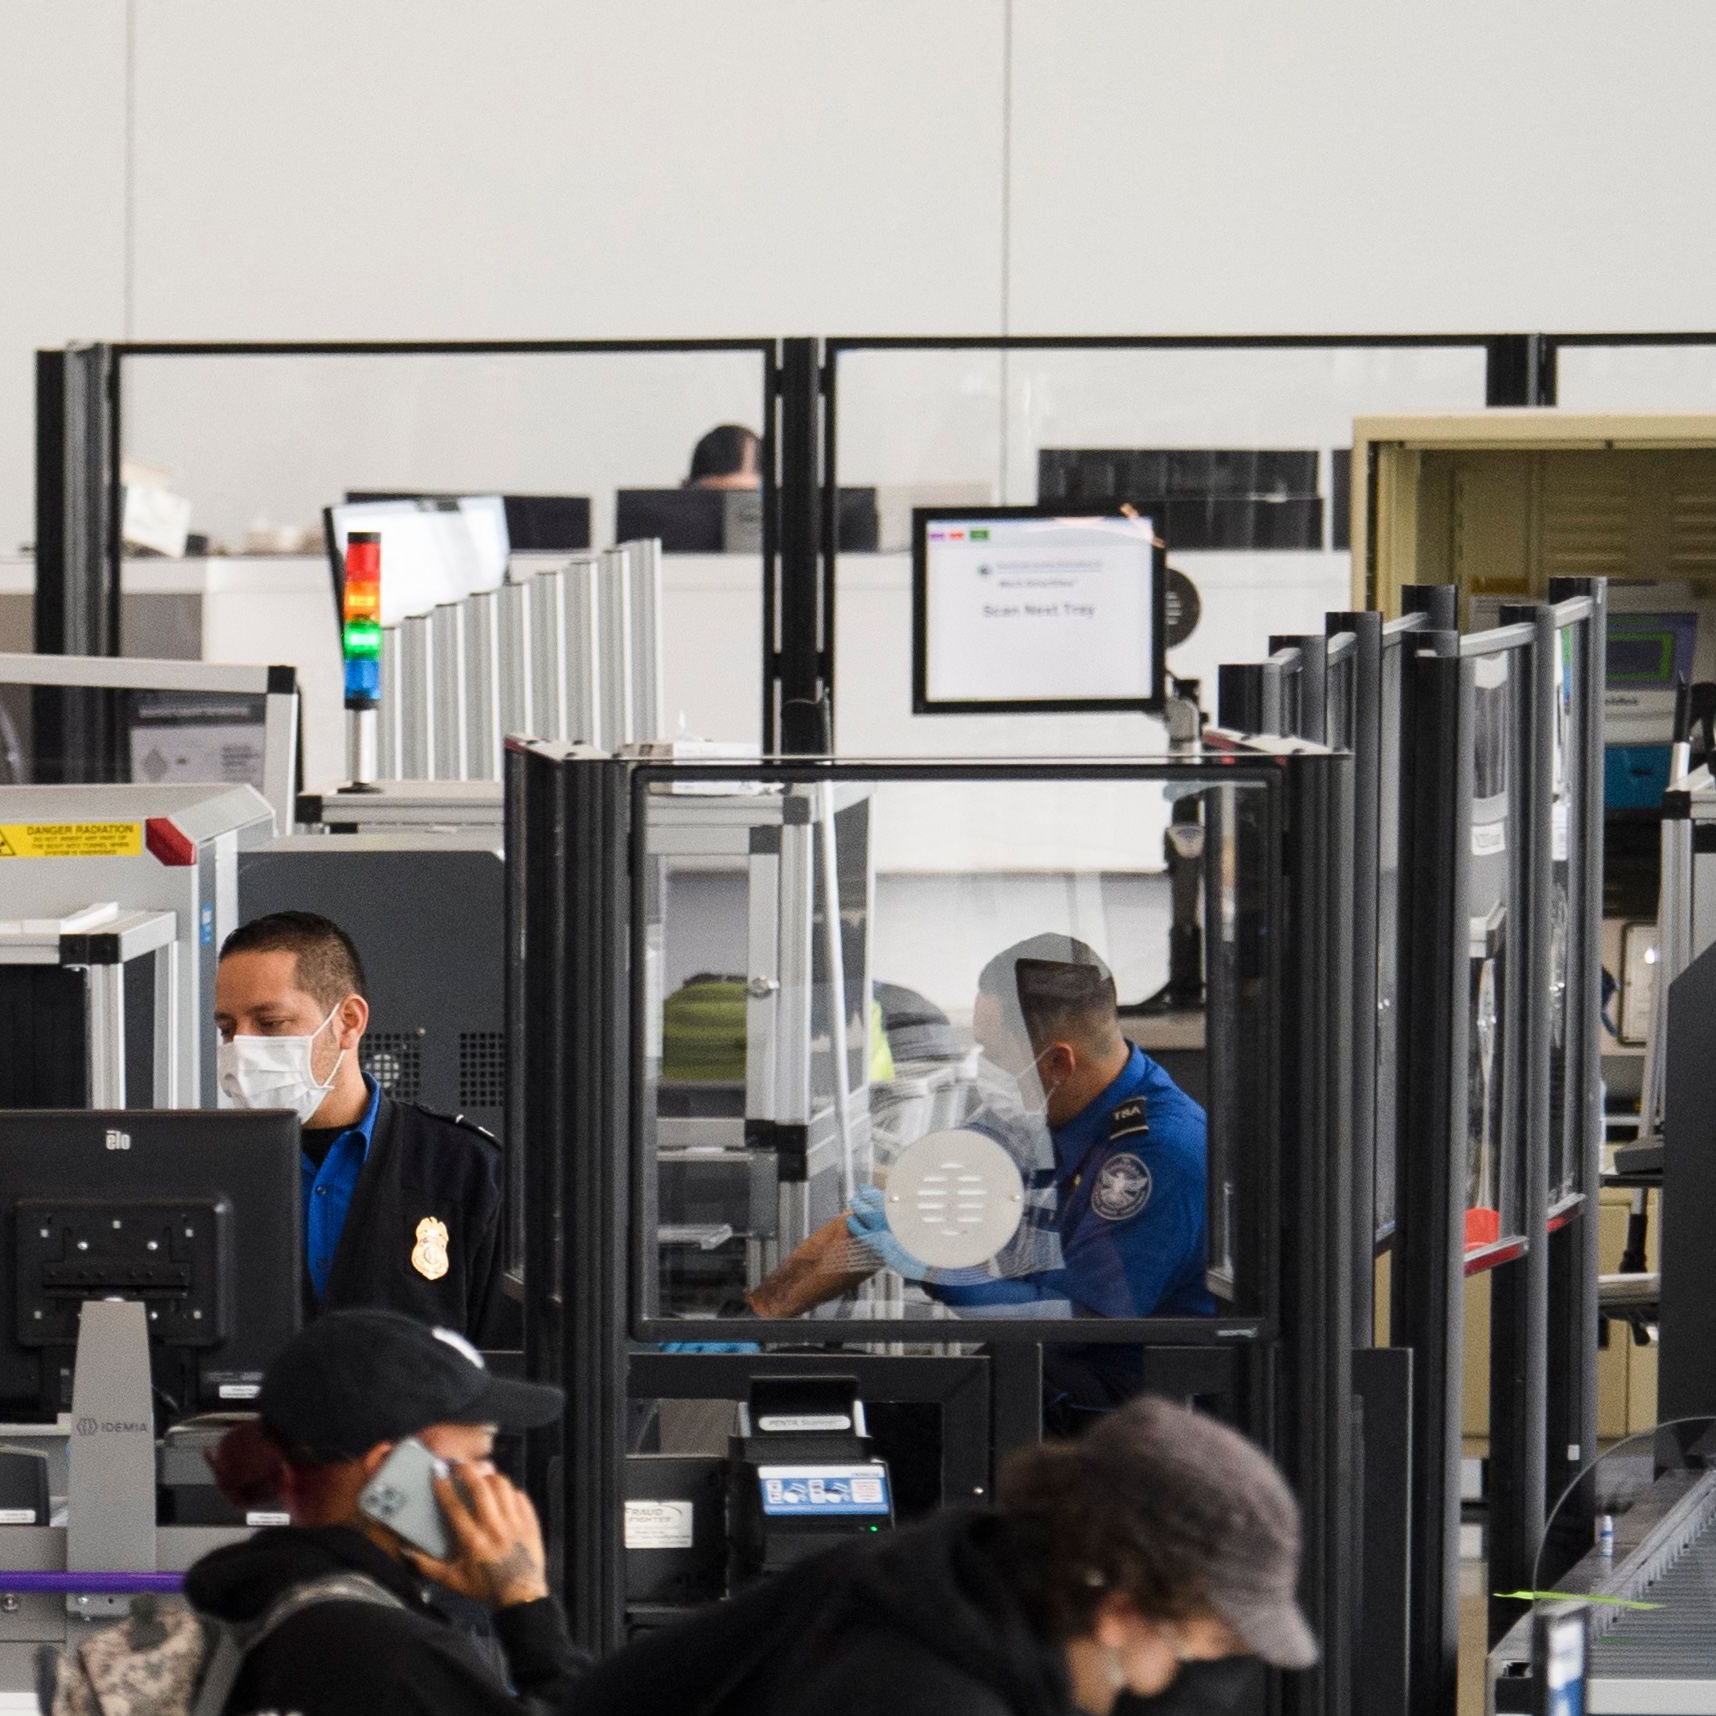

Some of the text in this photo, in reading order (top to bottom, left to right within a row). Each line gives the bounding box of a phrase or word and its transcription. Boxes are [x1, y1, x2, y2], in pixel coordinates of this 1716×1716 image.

[26, 824, 134, 836] DANGER RADIATION
[1113, 1105, 1142, 1120] TSA
[101, 1423, 148, 1433] IDEMIA
